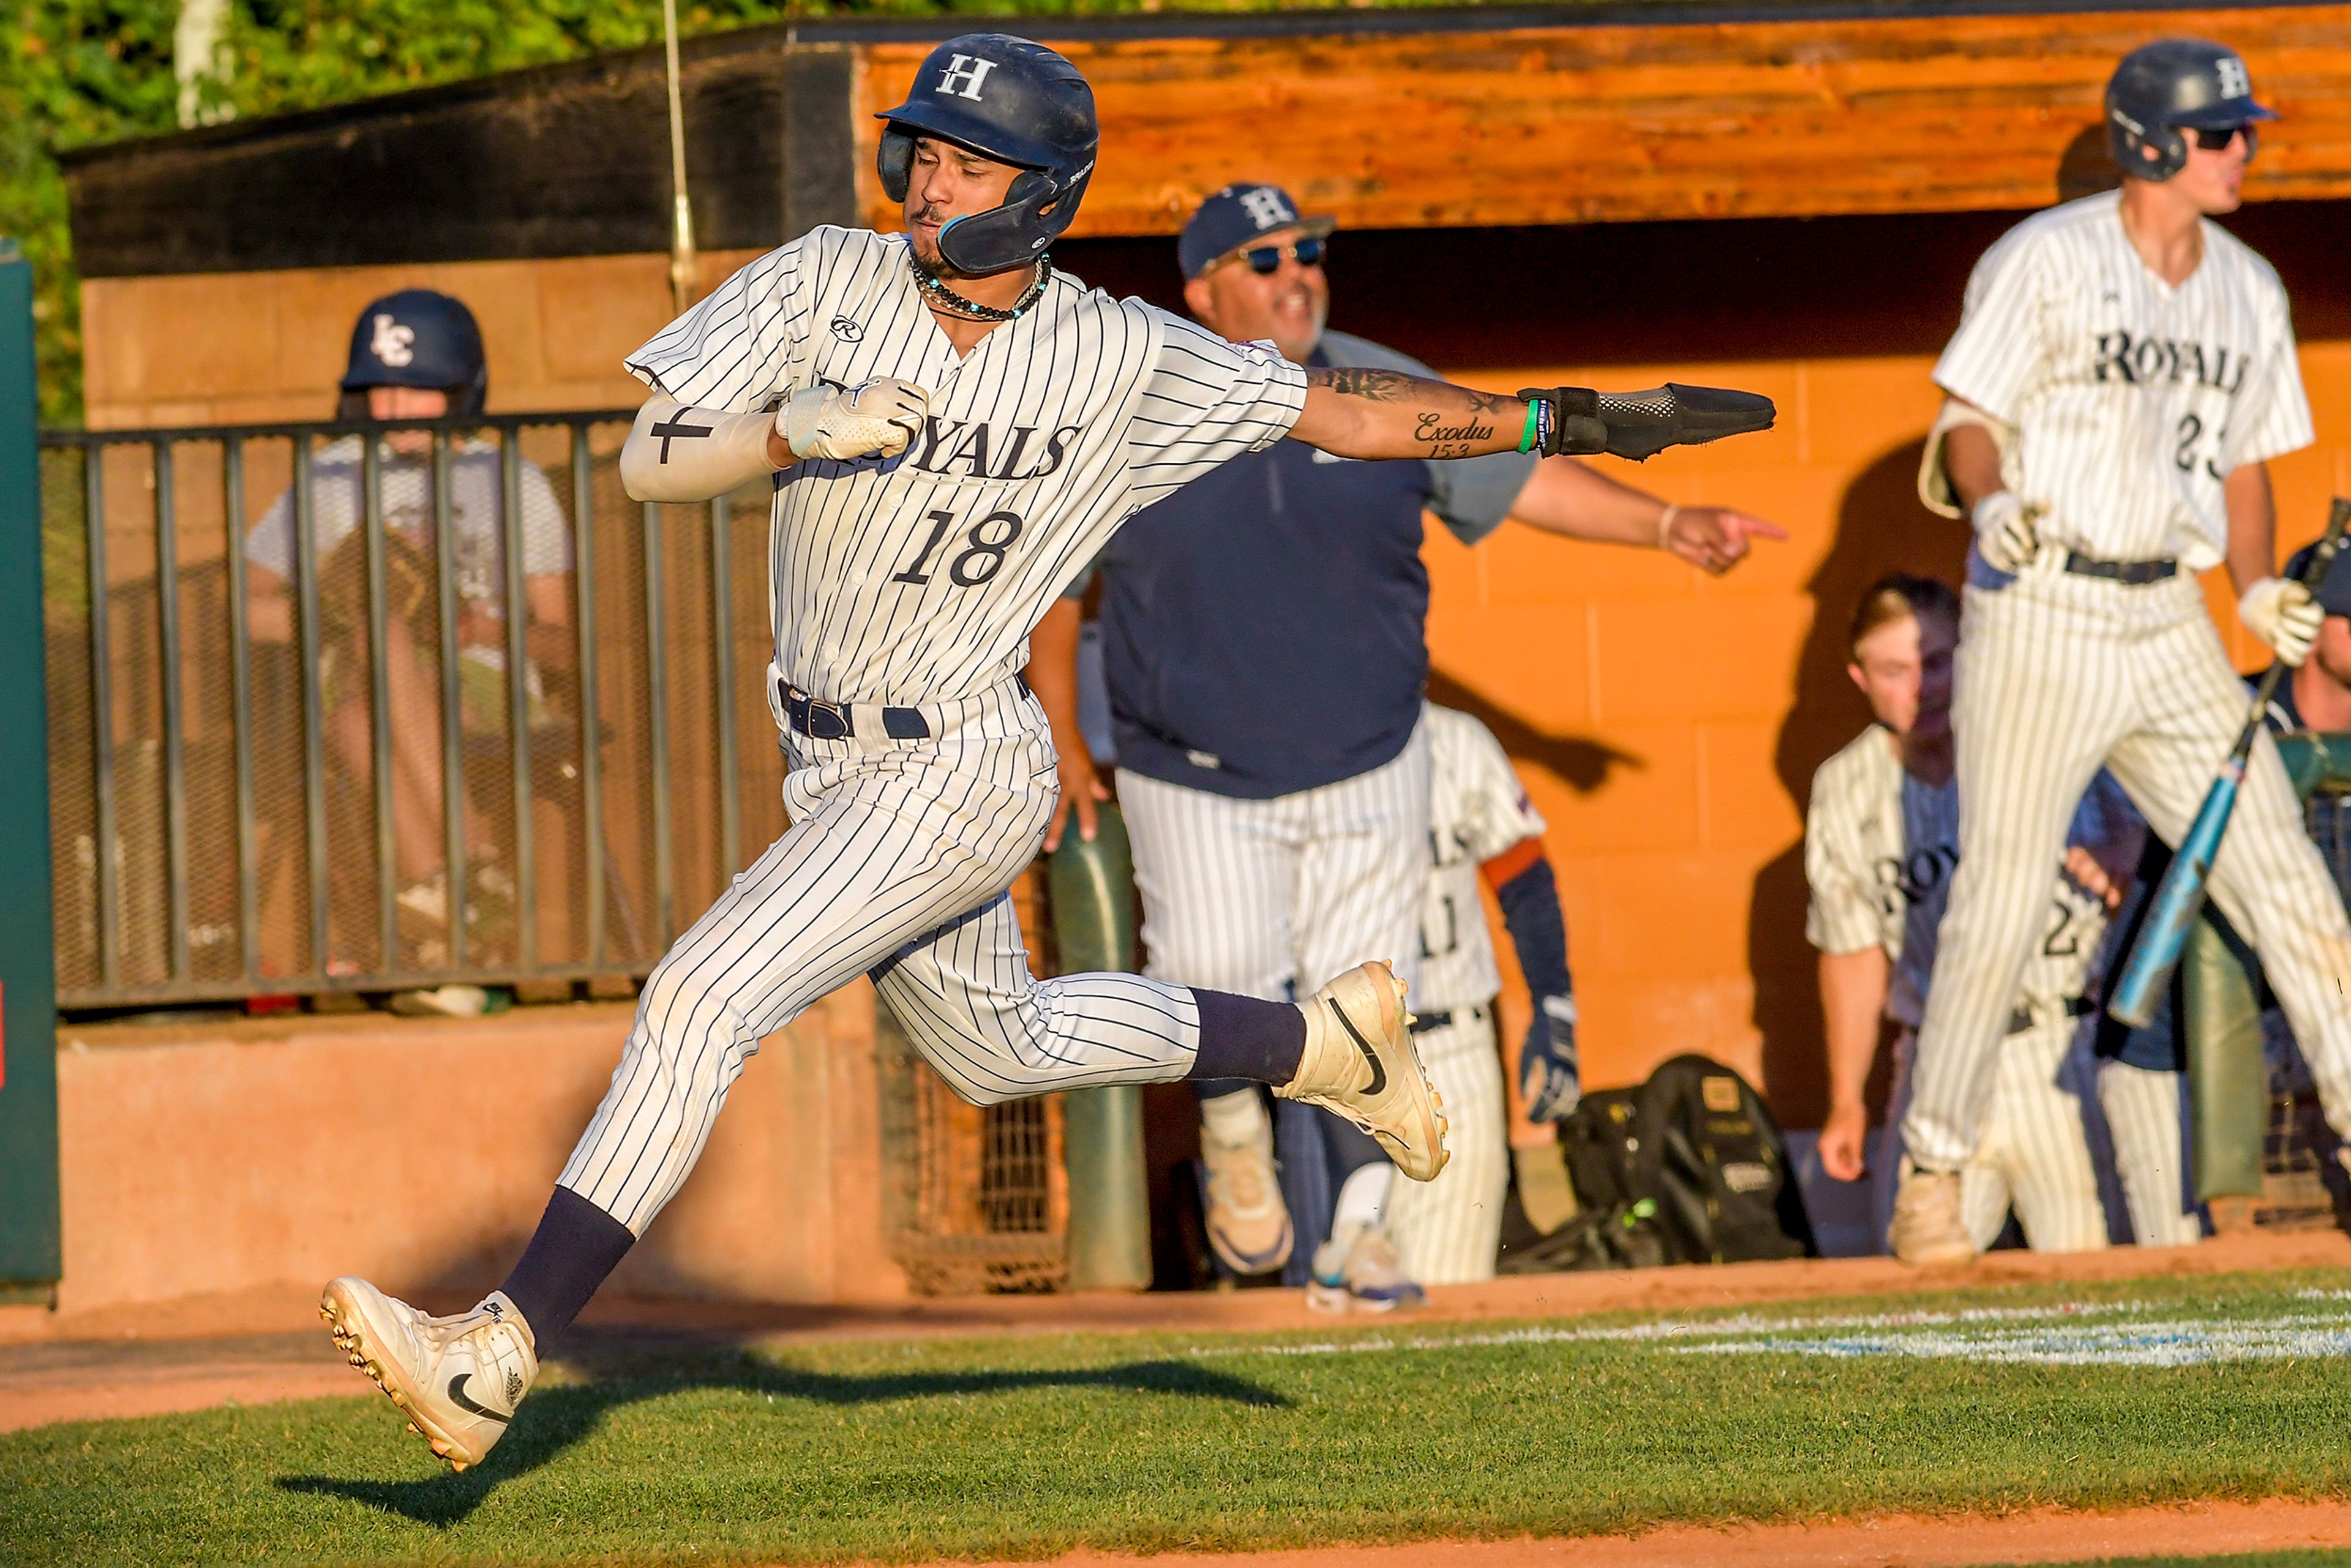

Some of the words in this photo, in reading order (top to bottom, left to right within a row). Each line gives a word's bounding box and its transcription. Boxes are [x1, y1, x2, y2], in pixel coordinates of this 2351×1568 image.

[935, 53, 999, 102] H
[2216, 57, 2250, 99] H
[1239, 187, 1294, 230] H
[1414, 413, 1494, 441] Exodus
[891, 509, 1022, 587] 18
